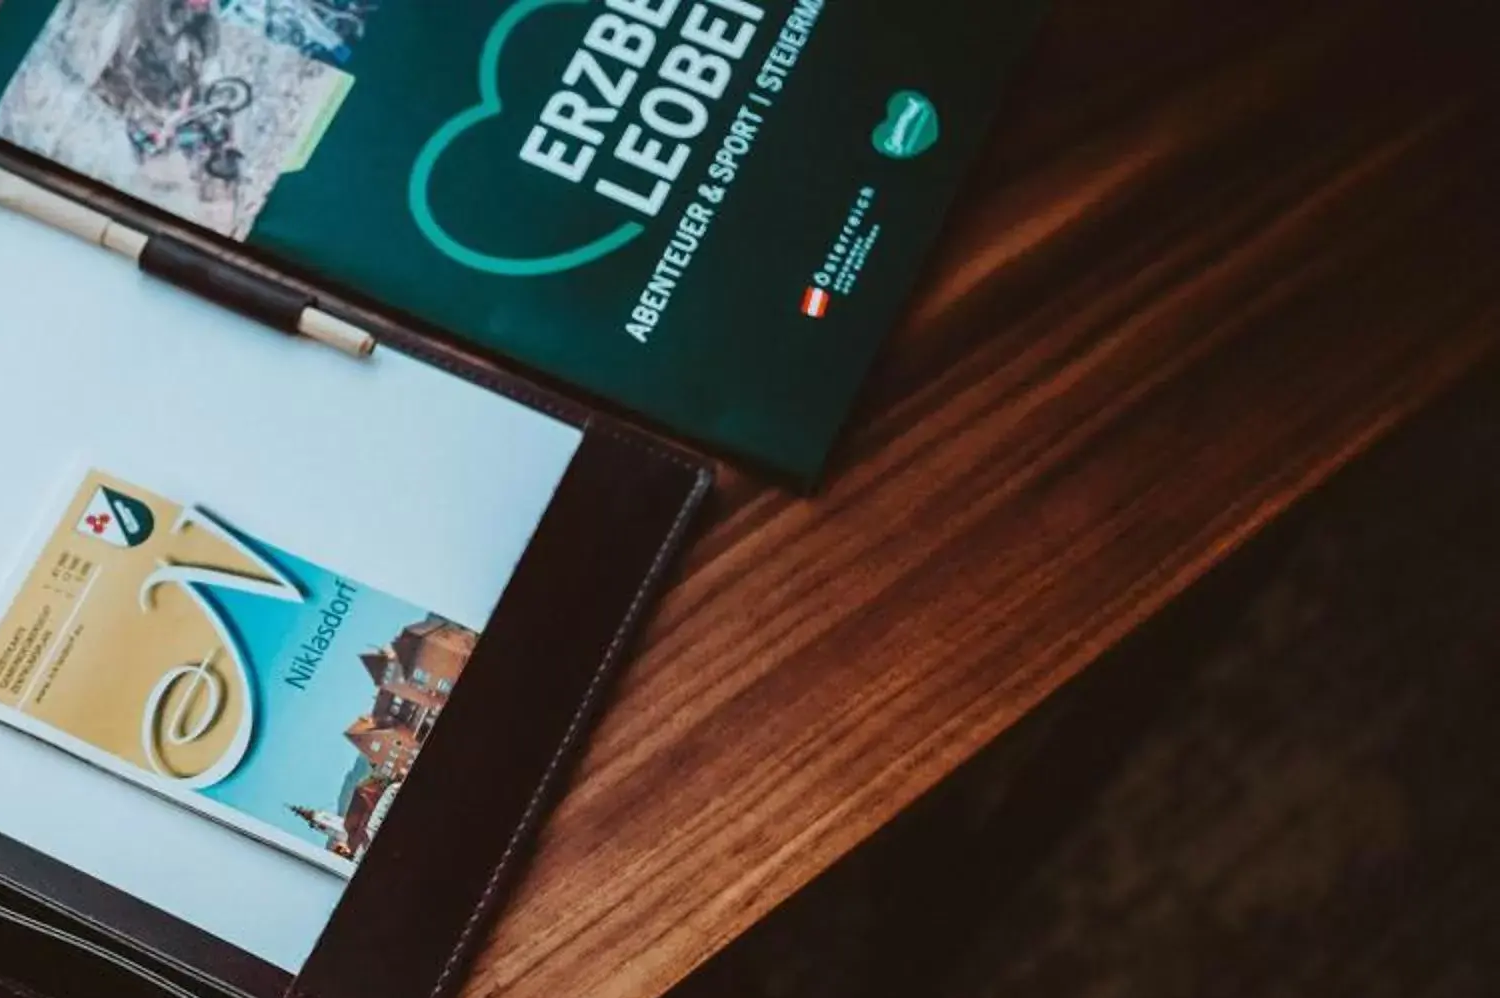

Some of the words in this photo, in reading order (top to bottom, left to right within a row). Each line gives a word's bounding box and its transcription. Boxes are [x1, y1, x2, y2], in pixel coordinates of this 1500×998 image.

[708, 104, 764, 183] SPORT
[697, 184, 726, 203] &
[625, 203, 714, 342] ABENTEUER
[282, 577, 357, 691] Niklasdorf
